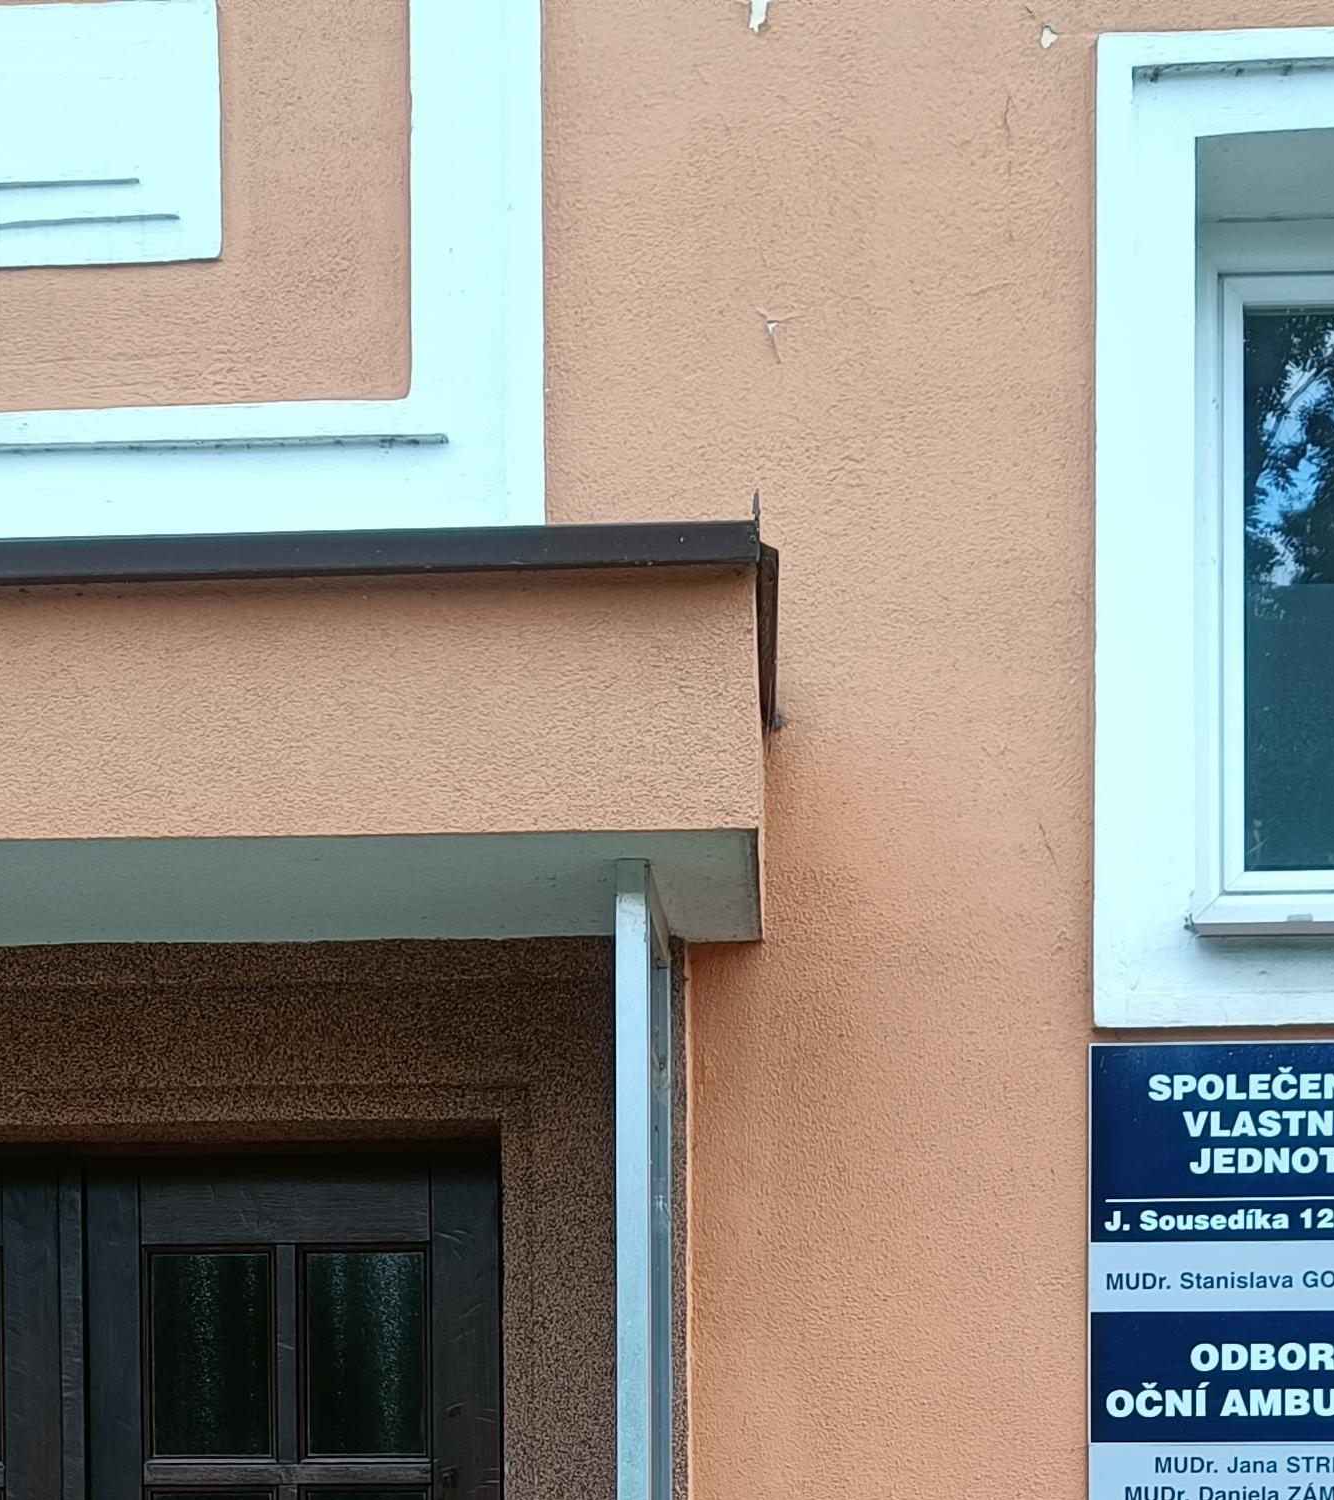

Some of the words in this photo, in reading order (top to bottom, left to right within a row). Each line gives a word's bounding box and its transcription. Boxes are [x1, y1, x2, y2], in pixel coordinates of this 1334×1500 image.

[1105, 1211, 1130, 1231] J.
[1140, 1209, 1289, 1231] Sousedíka
[1106, 1273, 1170, 1291] MUDr.
[1180, 1271, 1293, 1289] Stanislava
[1105, 1381, 1210, 1418] OČNÍ
[1154, 1457, 1218, 1474] MUDr.
[1226, 1457, 1278, 1474] Jana
